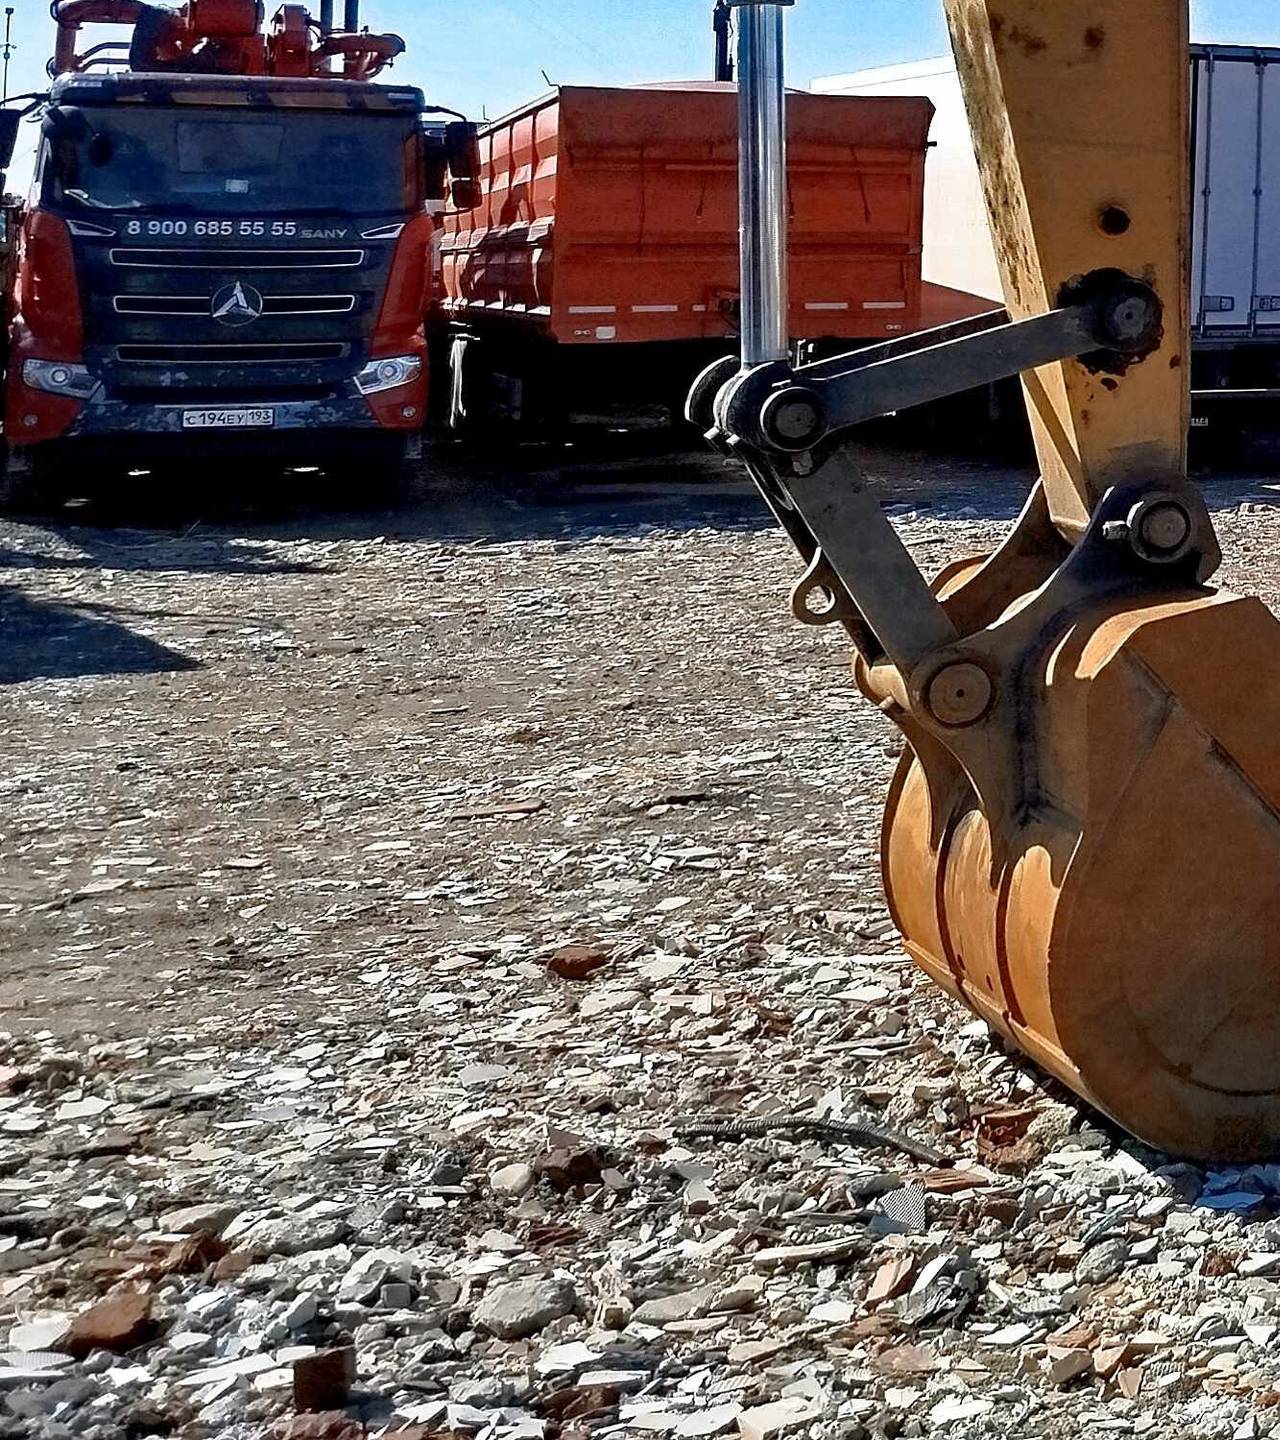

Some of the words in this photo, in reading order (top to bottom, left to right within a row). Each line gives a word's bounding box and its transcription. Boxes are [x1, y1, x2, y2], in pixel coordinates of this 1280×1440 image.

[127, 220, 141, 235] 8
[148, 220, 188, 235] 900
[194, 220, 233, 235] 685
[239, 220, 265, 235] 55
[271, 220, 297, 235] 55
[300, 229, 348, 239] SANY
